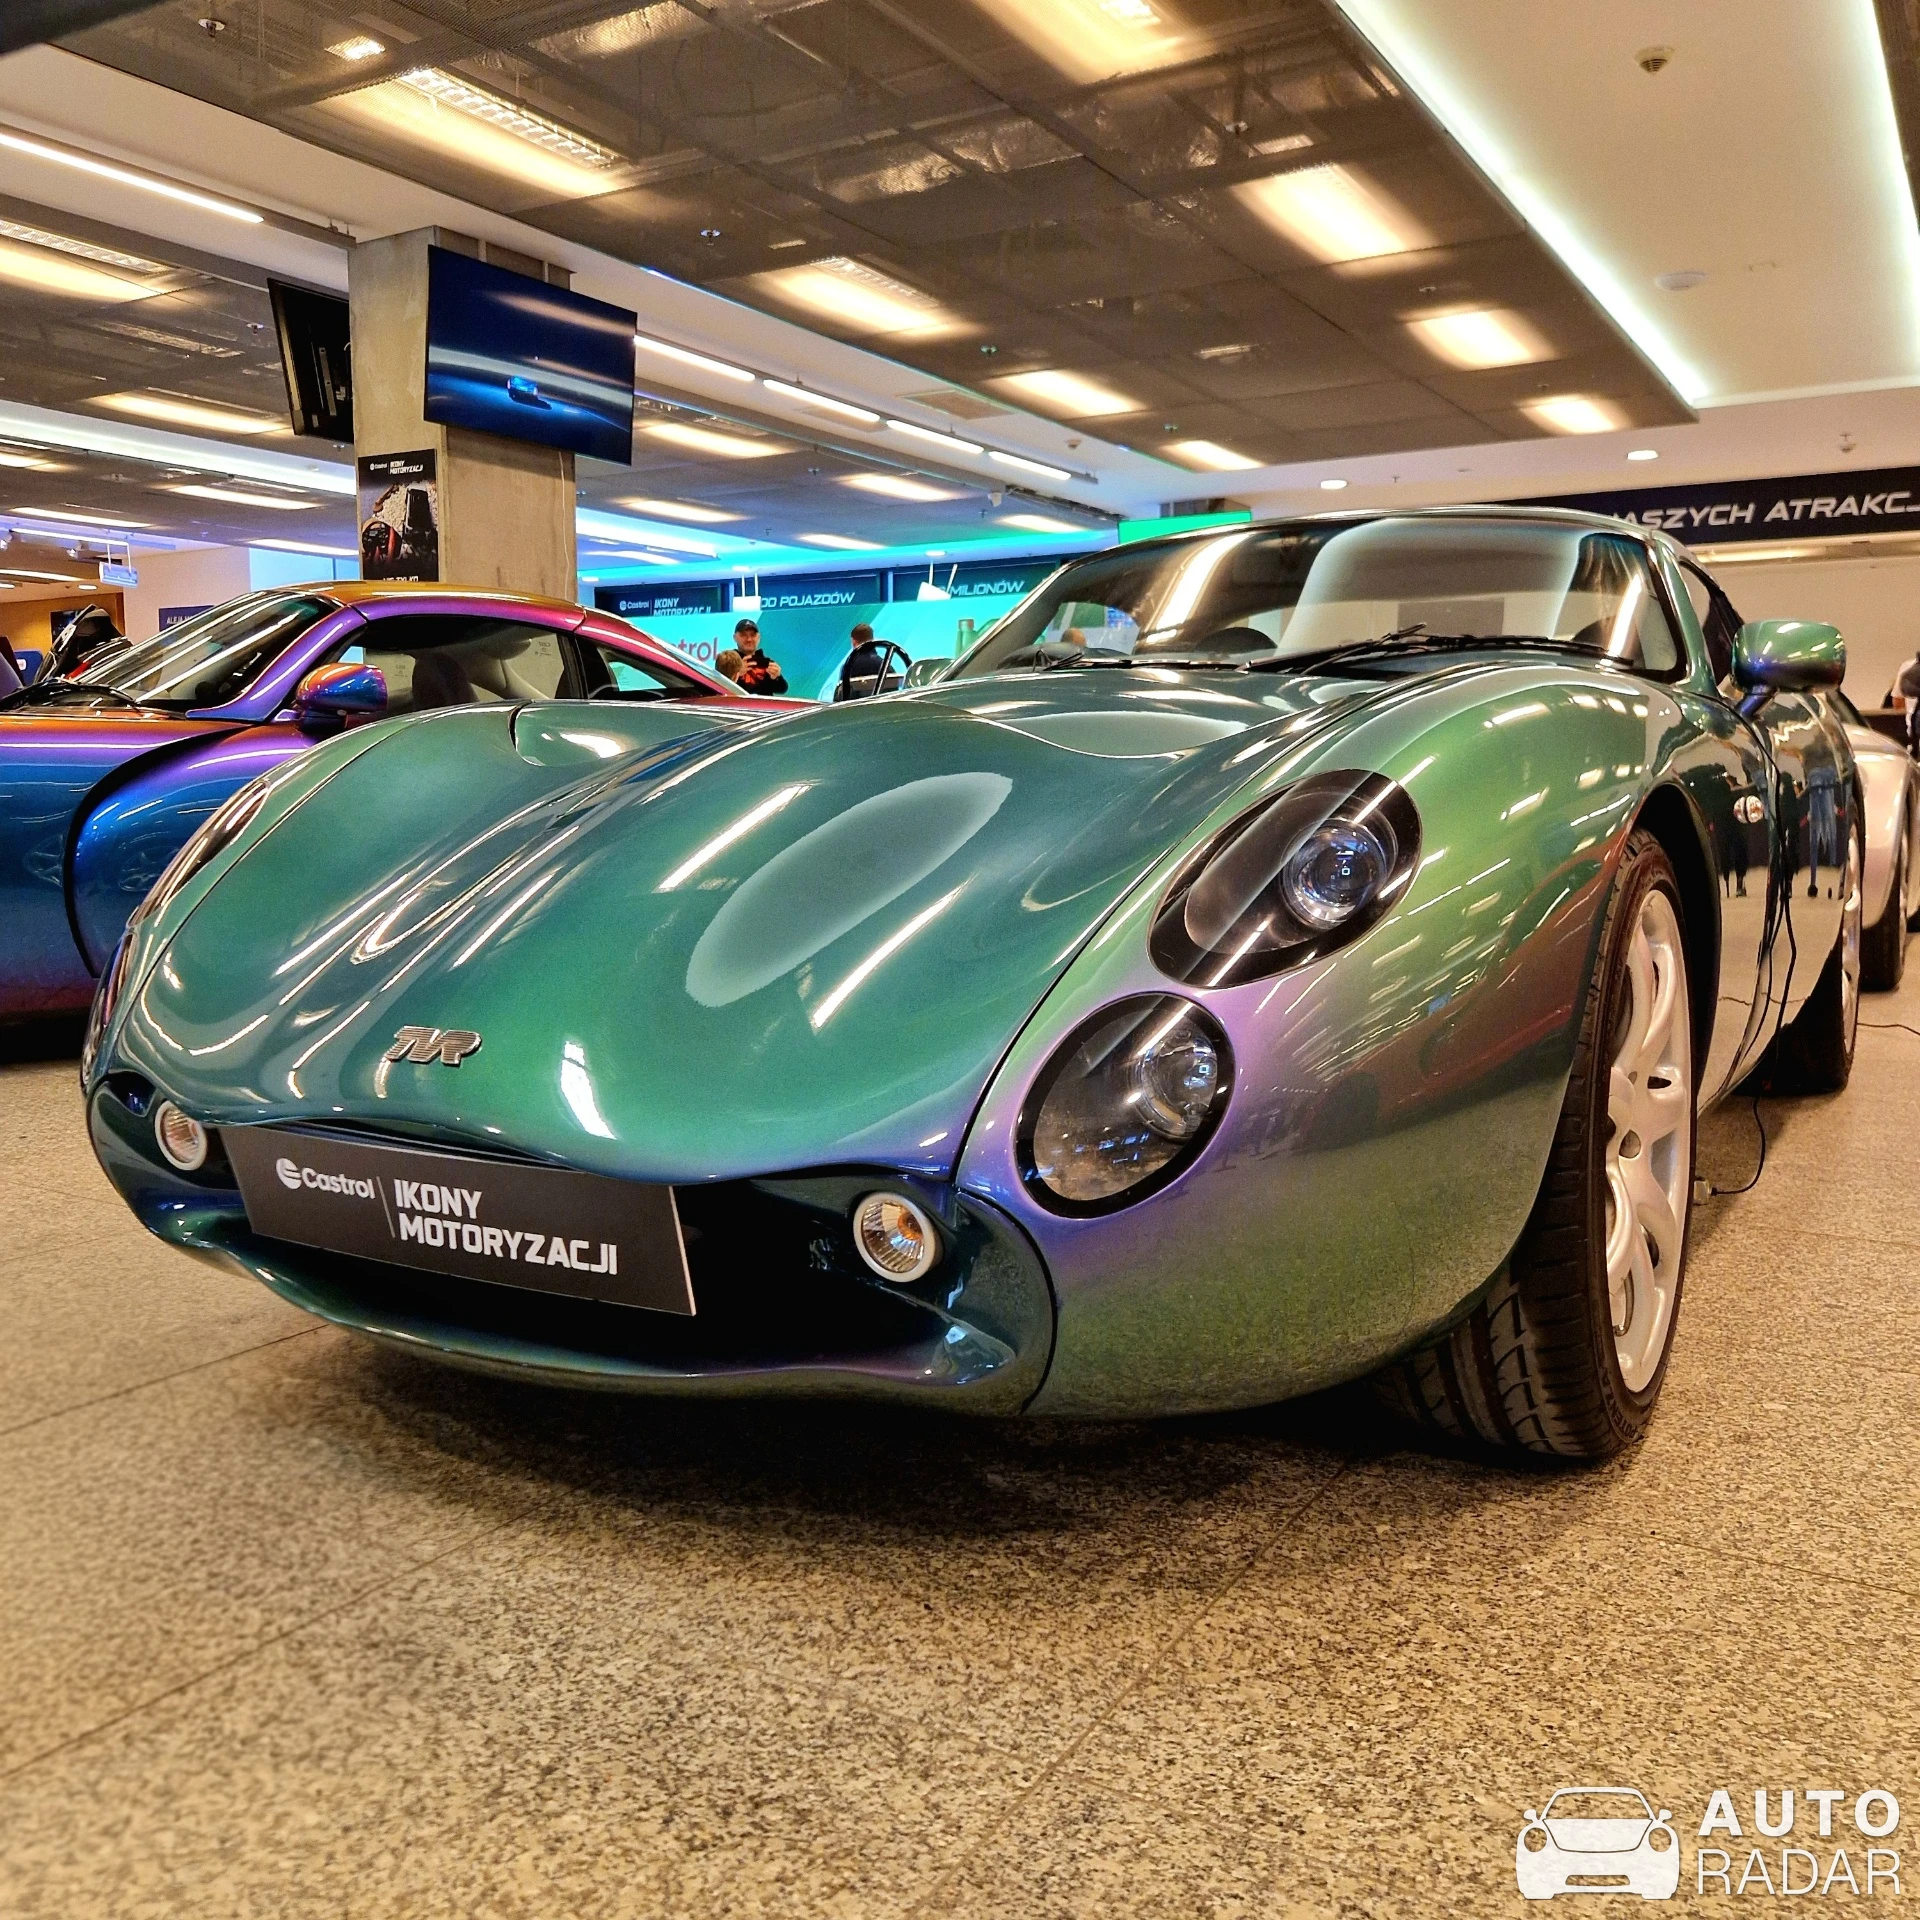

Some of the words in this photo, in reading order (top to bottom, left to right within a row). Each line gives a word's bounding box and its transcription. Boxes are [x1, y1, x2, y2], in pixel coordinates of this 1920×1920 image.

[1613, 502, 1755, 530] ASZYCH
[627, 599, 649, 610] Castrol
[654, 597, 679, 609] IKONY
[779, 591, 856, 608] POJAZDÓW
[386, 1025, 483, 1067] TVR
[301, 1166, 376, 1200] Castrol
[394, 1178, 483, 1221] IKONY
[398, 1212, 619, 1276] MOTORYZACJI
